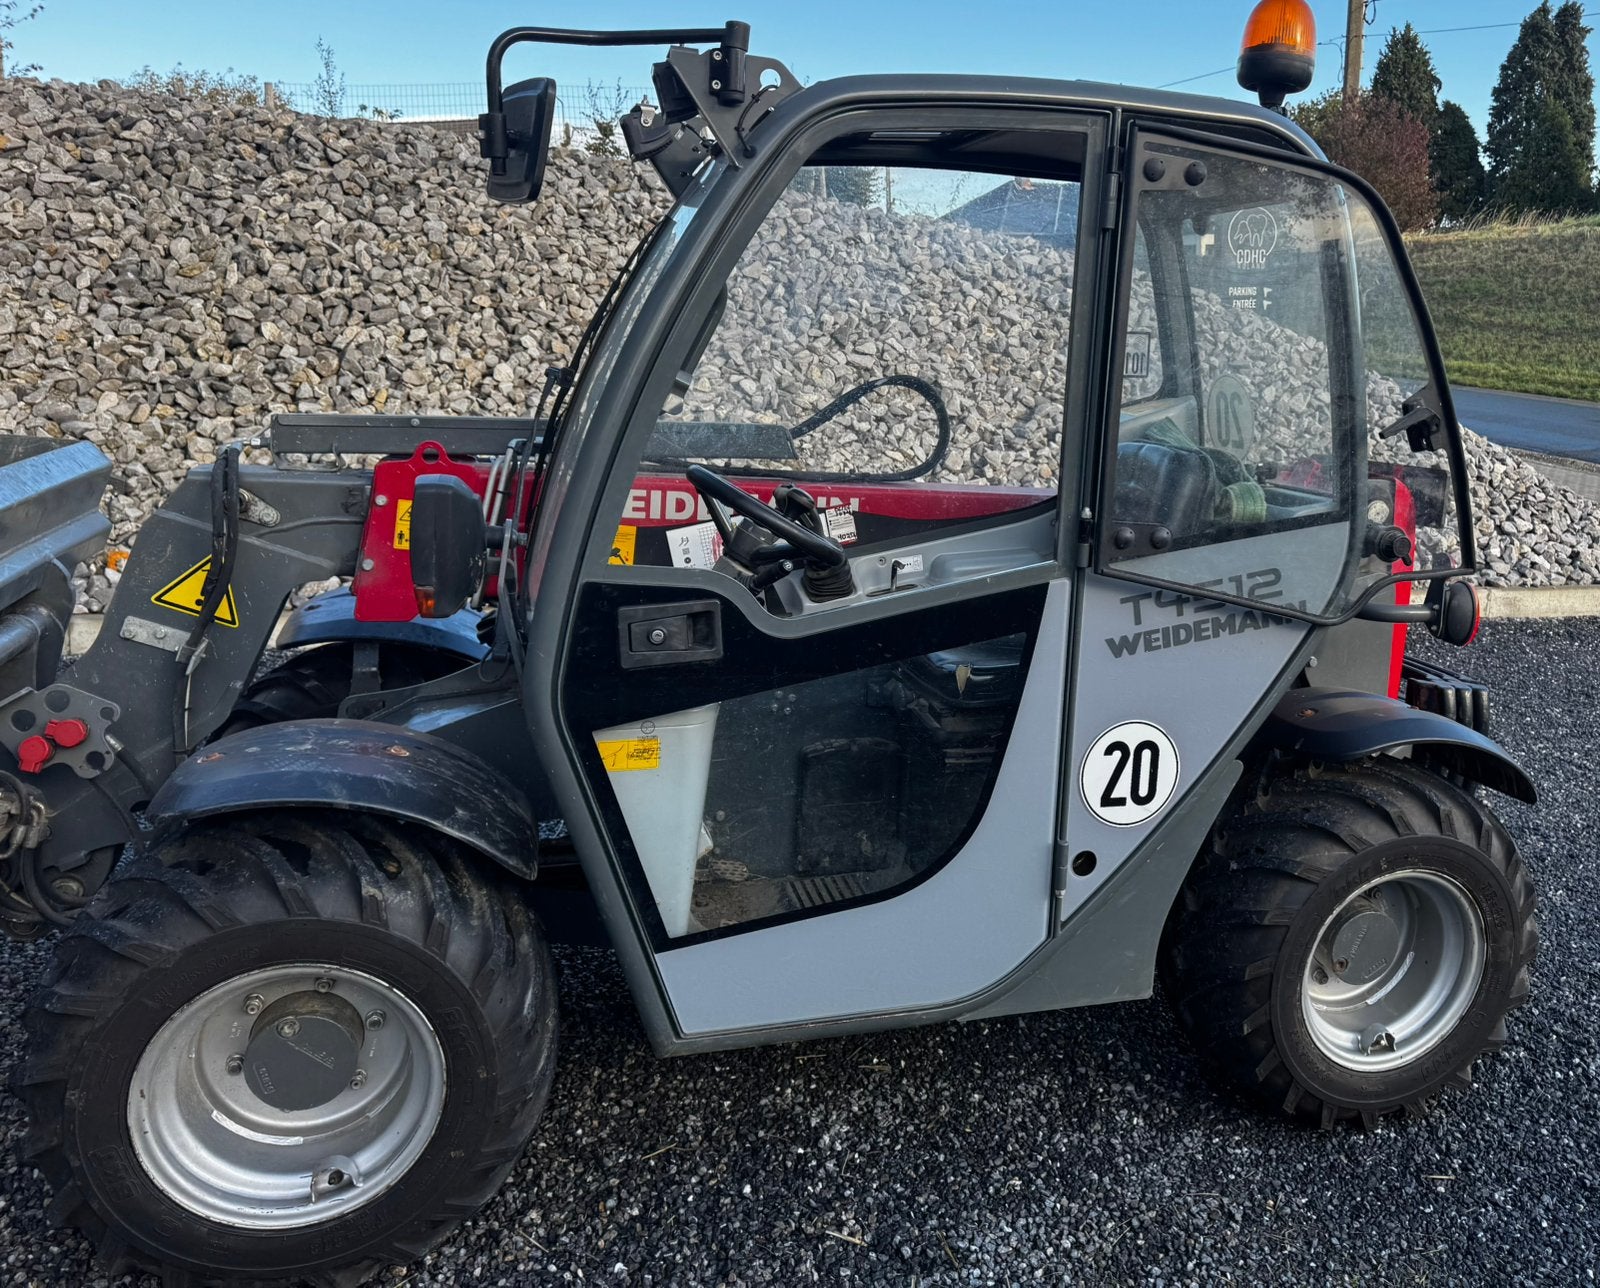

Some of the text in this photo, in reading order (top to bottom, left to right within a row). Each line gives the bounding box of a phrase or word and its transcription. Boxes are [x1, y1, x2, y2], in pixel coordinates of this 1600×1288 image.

[1236, 249, 1266, 264] CDHC
[1228, 286, 1257, 297] PARKING
[1100, 740, 1160, 807] 20
